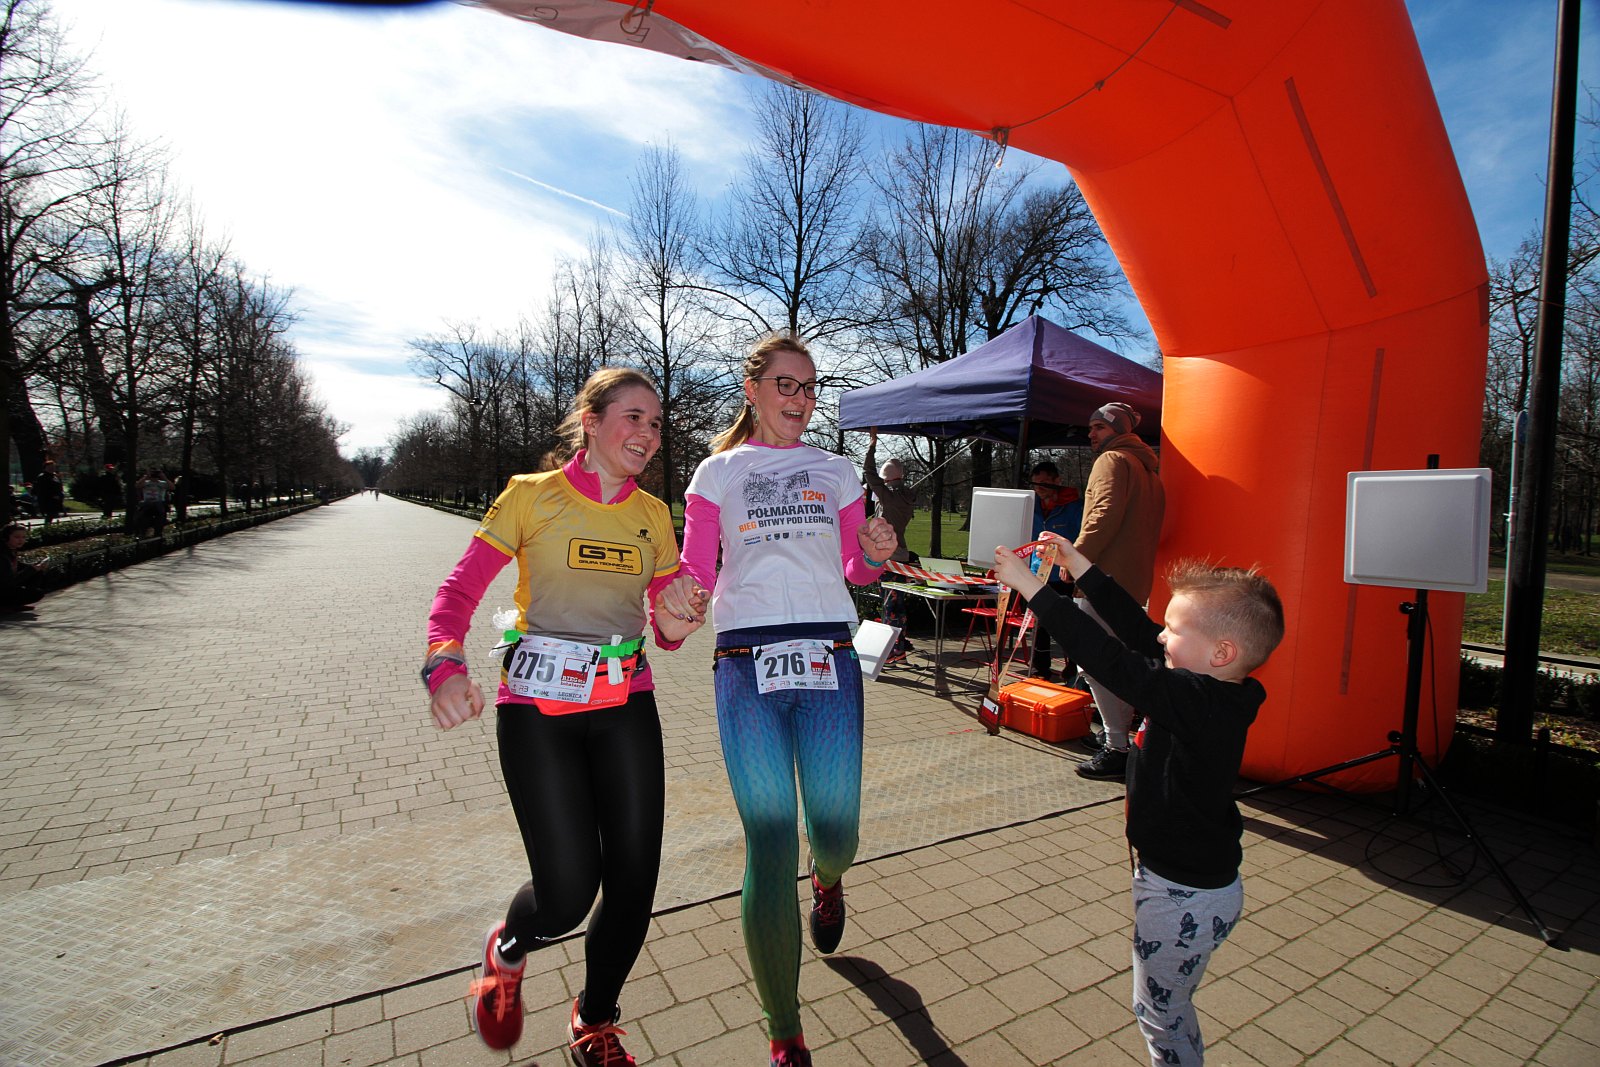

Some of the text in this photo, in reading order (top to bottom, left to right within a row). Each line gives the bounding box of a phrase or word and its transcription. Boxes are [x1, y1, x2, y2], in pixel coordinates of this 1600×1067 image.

[802, 491, 826, 502] 1241
[747, 503, 825, 520] PÓŁMARATON
[738, 521, 757, 533] BIEG
[758, 517, 786, 528] BITWY
[786, 516, 803, 525] POD
[578, 544, 633, 563] GT
[512, 650, 557, 683] 275
[763, 652, 806, 679] 276
